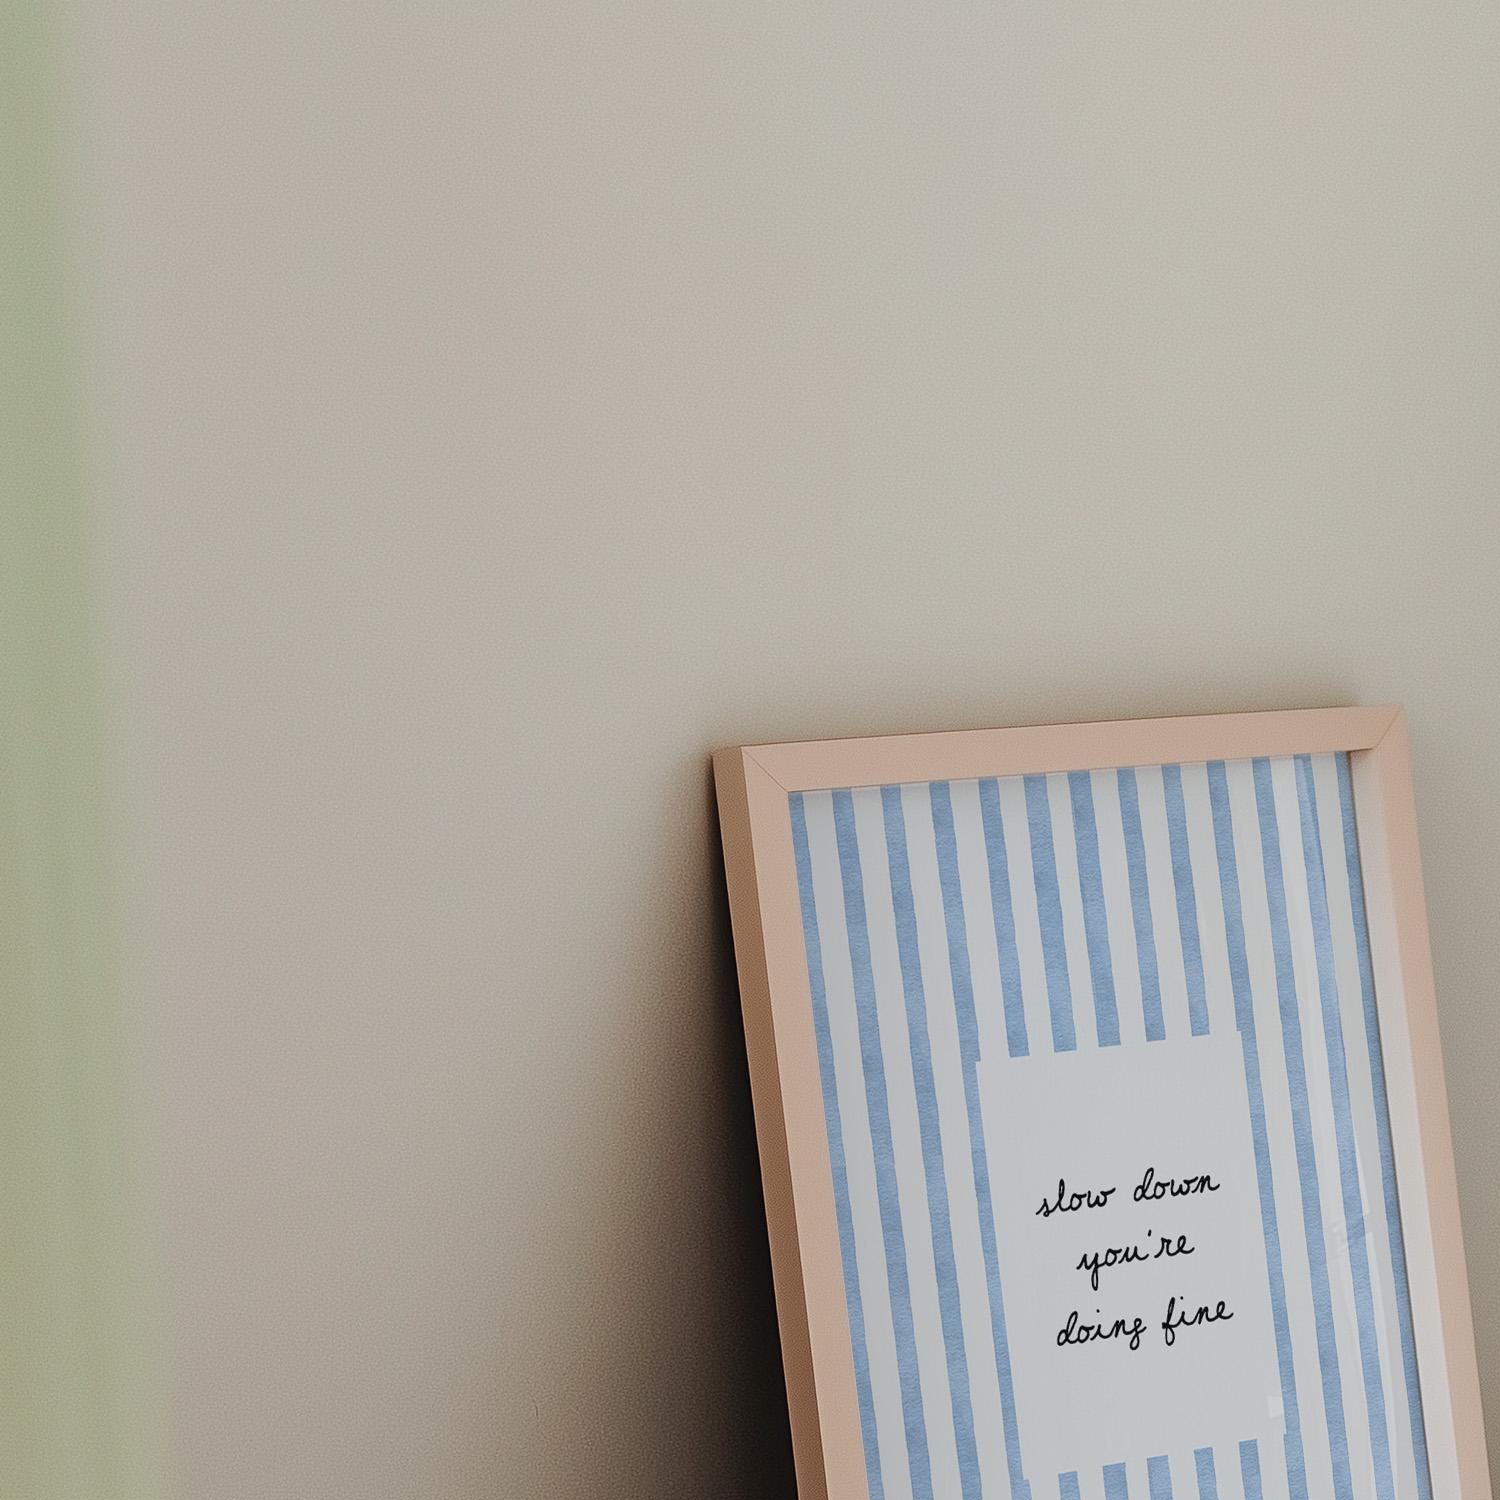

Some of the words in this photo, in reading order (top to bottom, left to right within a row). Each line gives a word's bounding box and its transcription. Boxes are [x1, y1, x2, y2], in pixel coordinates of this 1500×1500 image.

[1035, 1178, 1117, 1217] slow
[1133, 1167, 1220, 1202] down
[1076, 1229, 1195, 1291] you're
[1057, 1308, 1148, 1351] doing
[1162, 1296, 1234, 1346] fine
